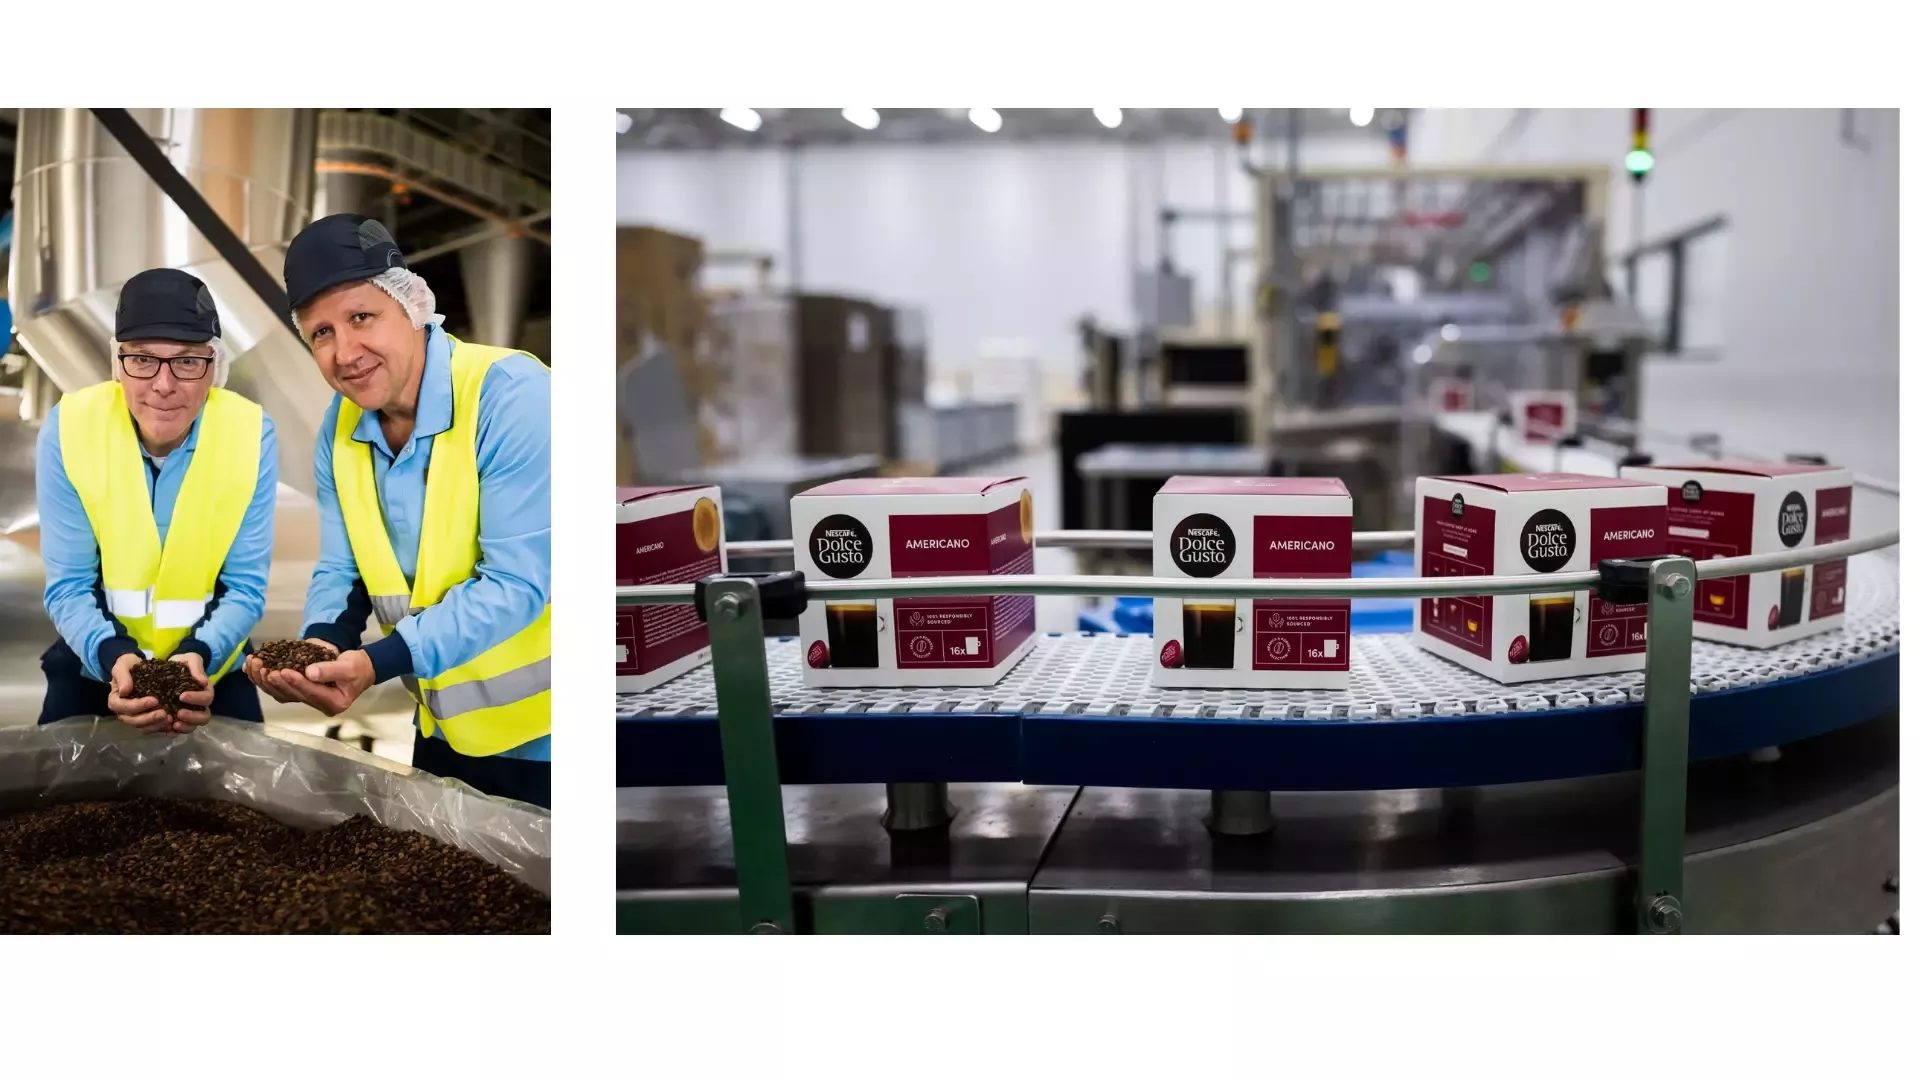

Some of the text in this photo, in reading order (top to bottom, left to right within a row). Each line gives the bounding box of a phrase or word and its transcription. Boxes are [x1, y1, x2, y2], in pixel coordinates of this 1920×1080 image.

[1782, 511, 1804, 525] Dolce
[1528, 532, 1568, 547] Dolce
[1603, 529, 1655, 541] AMERICANO
[636, 541, 664, 555] AMERICANO
[817, 538, 862, 551] Dolce
[905, 539, 970, 549] AMERICANO
[1178, 537, 1225, 551] Dolce
[1269, 540, 1335, 550] AMERICANO
[819, 549, 864, 563] Gusto
[1180, 549, 1226, 563] Gusto
[1528, 545, 1568, 558] Gusto
[1631, 632, 1644, 641] 16x
[950, 647, 966, 655] 16x
[1308, 649, 1323, 658] 16x
